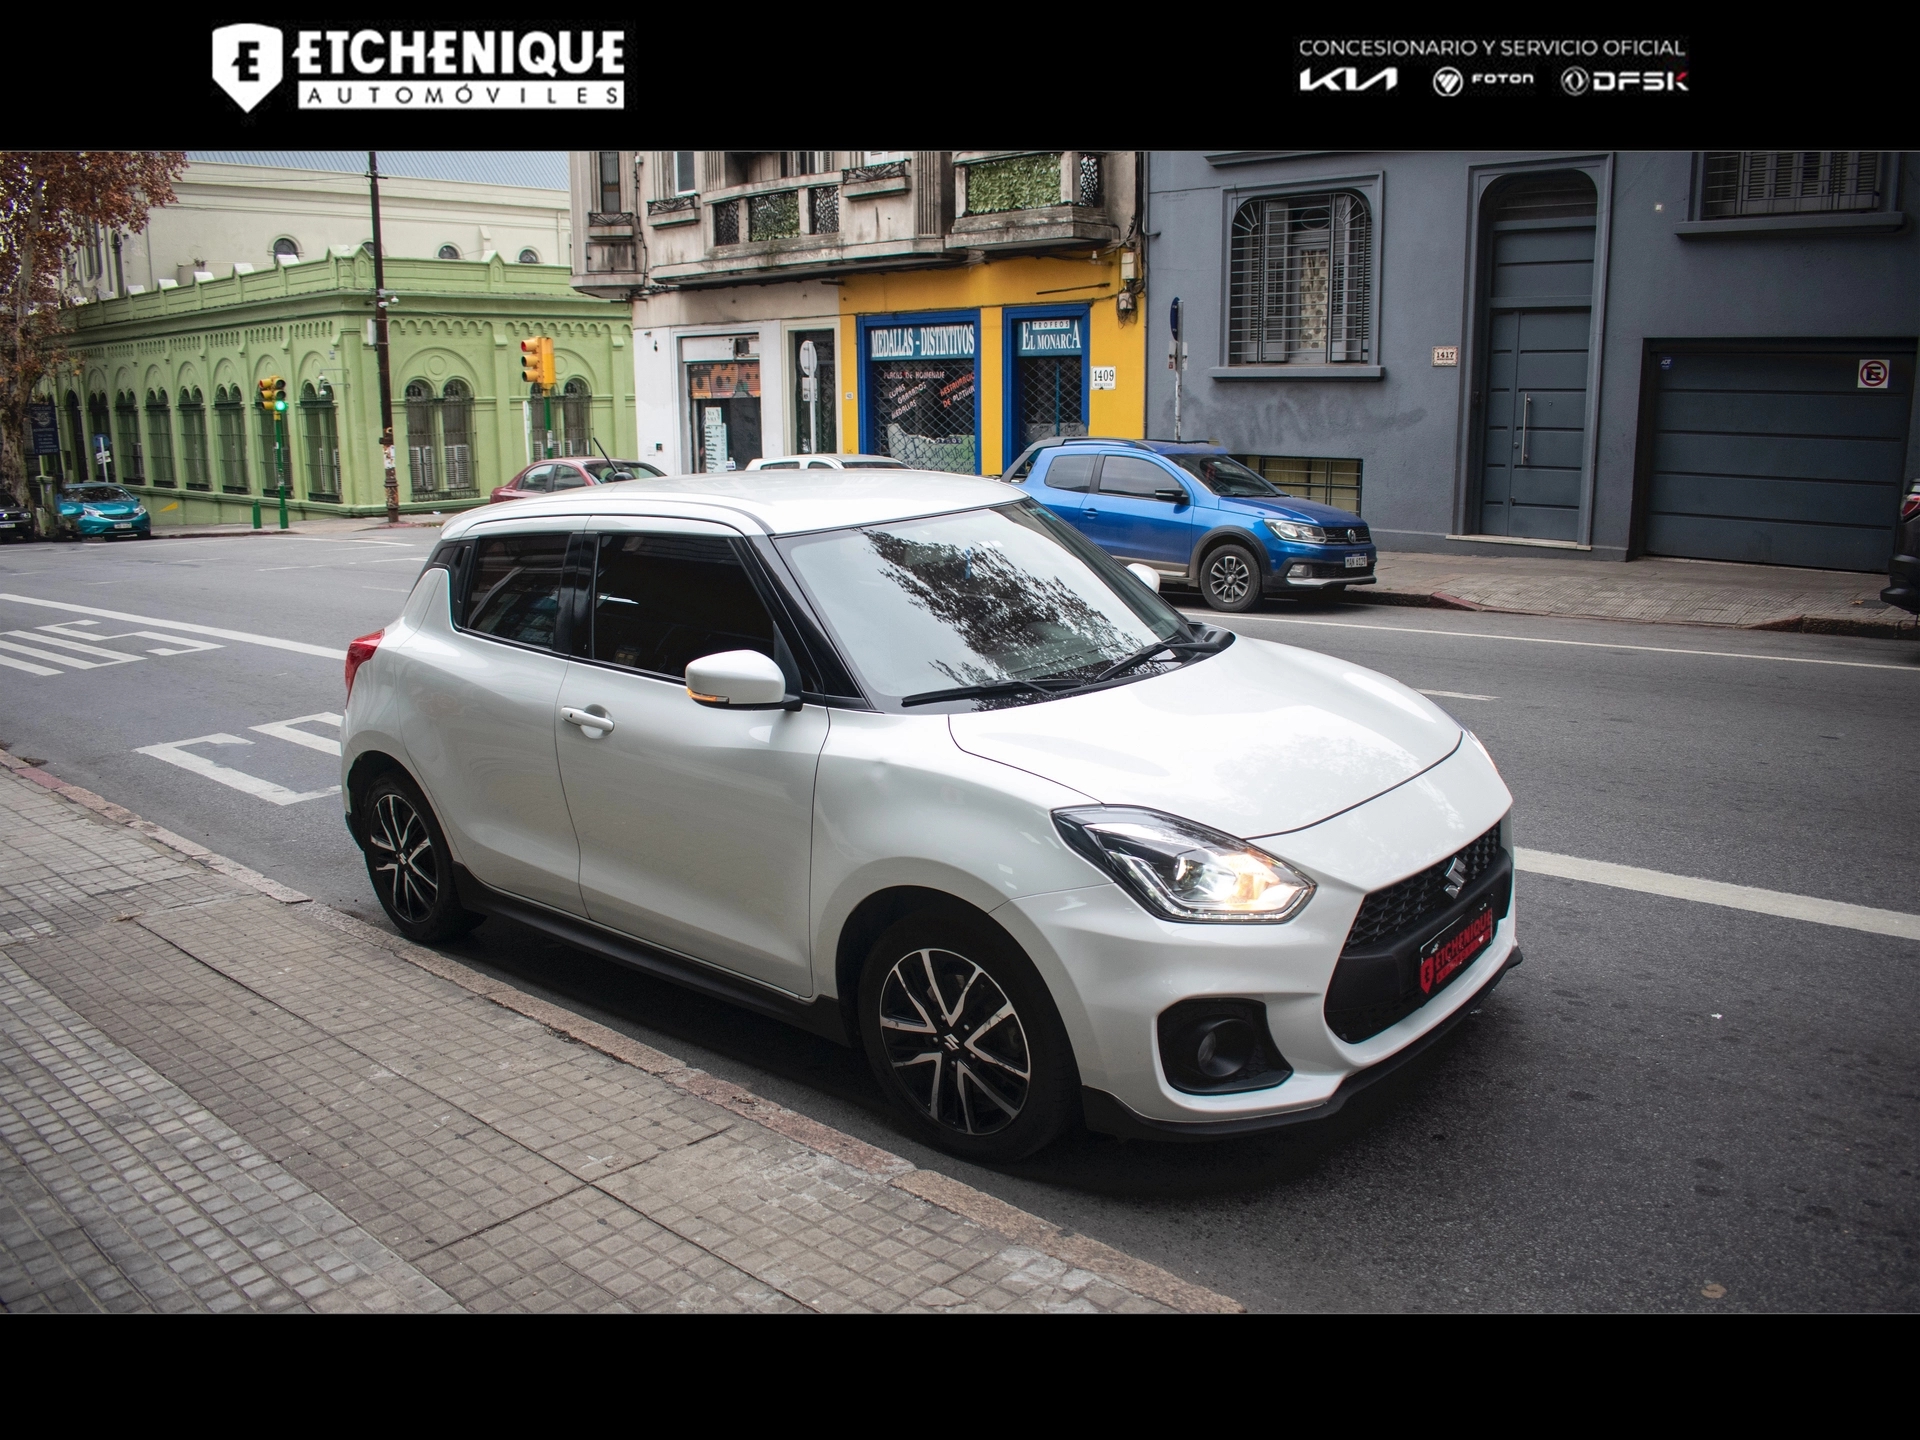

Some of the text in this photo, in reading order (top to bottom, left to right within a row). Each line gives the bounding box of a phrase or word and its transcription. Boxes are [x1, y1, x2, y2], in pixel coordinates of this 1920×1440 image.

[871, 328, 914, 357] MEDALLAS
[921, 324, 974, 356] DISTINTIVOS
[1022, 319, 1081, 350] EL MONARCA
[1094, 369, 1114, 381] 1409
